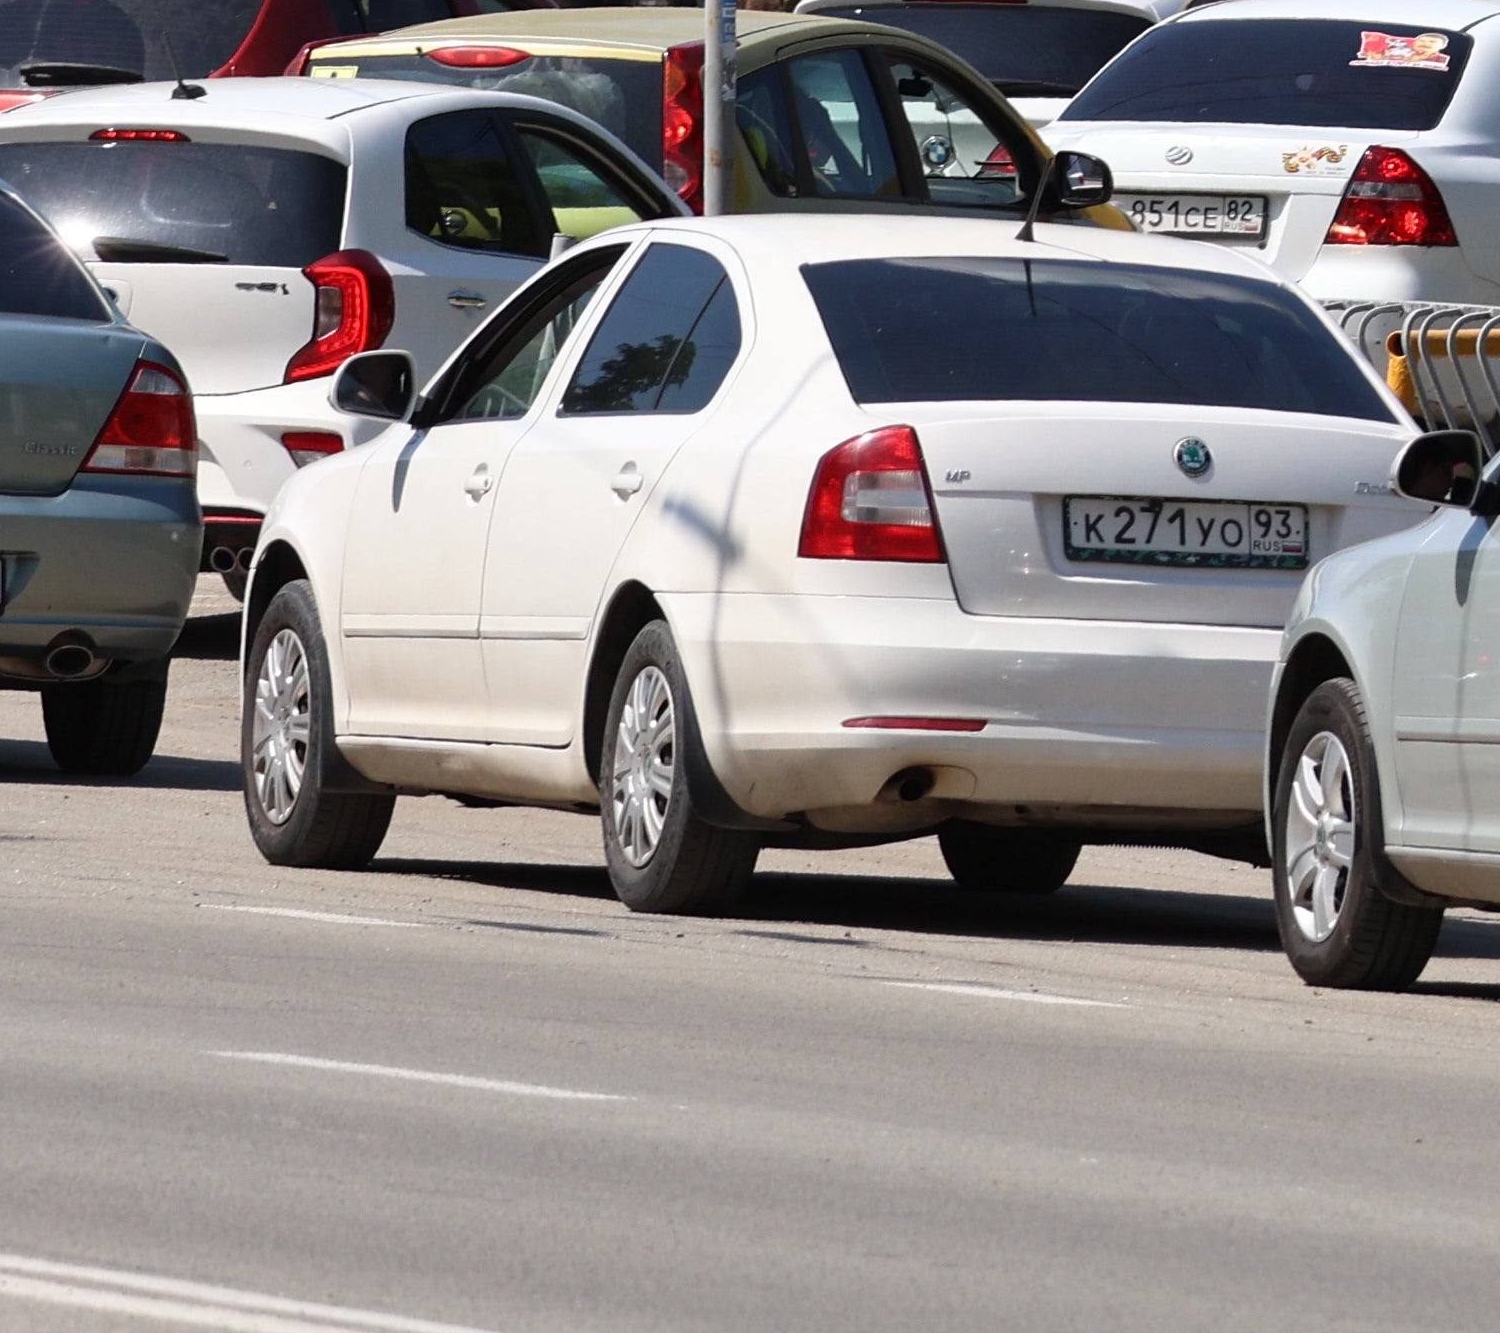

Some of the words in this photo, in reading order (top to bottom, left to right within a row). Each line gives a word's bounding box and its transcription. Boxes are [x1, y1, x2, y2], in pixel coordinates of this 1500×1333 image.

[1131, 199, 1219, 229] 851СЕ
[1226, 200, 1254, 222] 82
[1225, 222, 1246, 231] RUS
[1085, 506, 1243, 547] К271УО
[1254, 509, 1292, 539] 93
[1253, 540, 1281, 552] RUS
